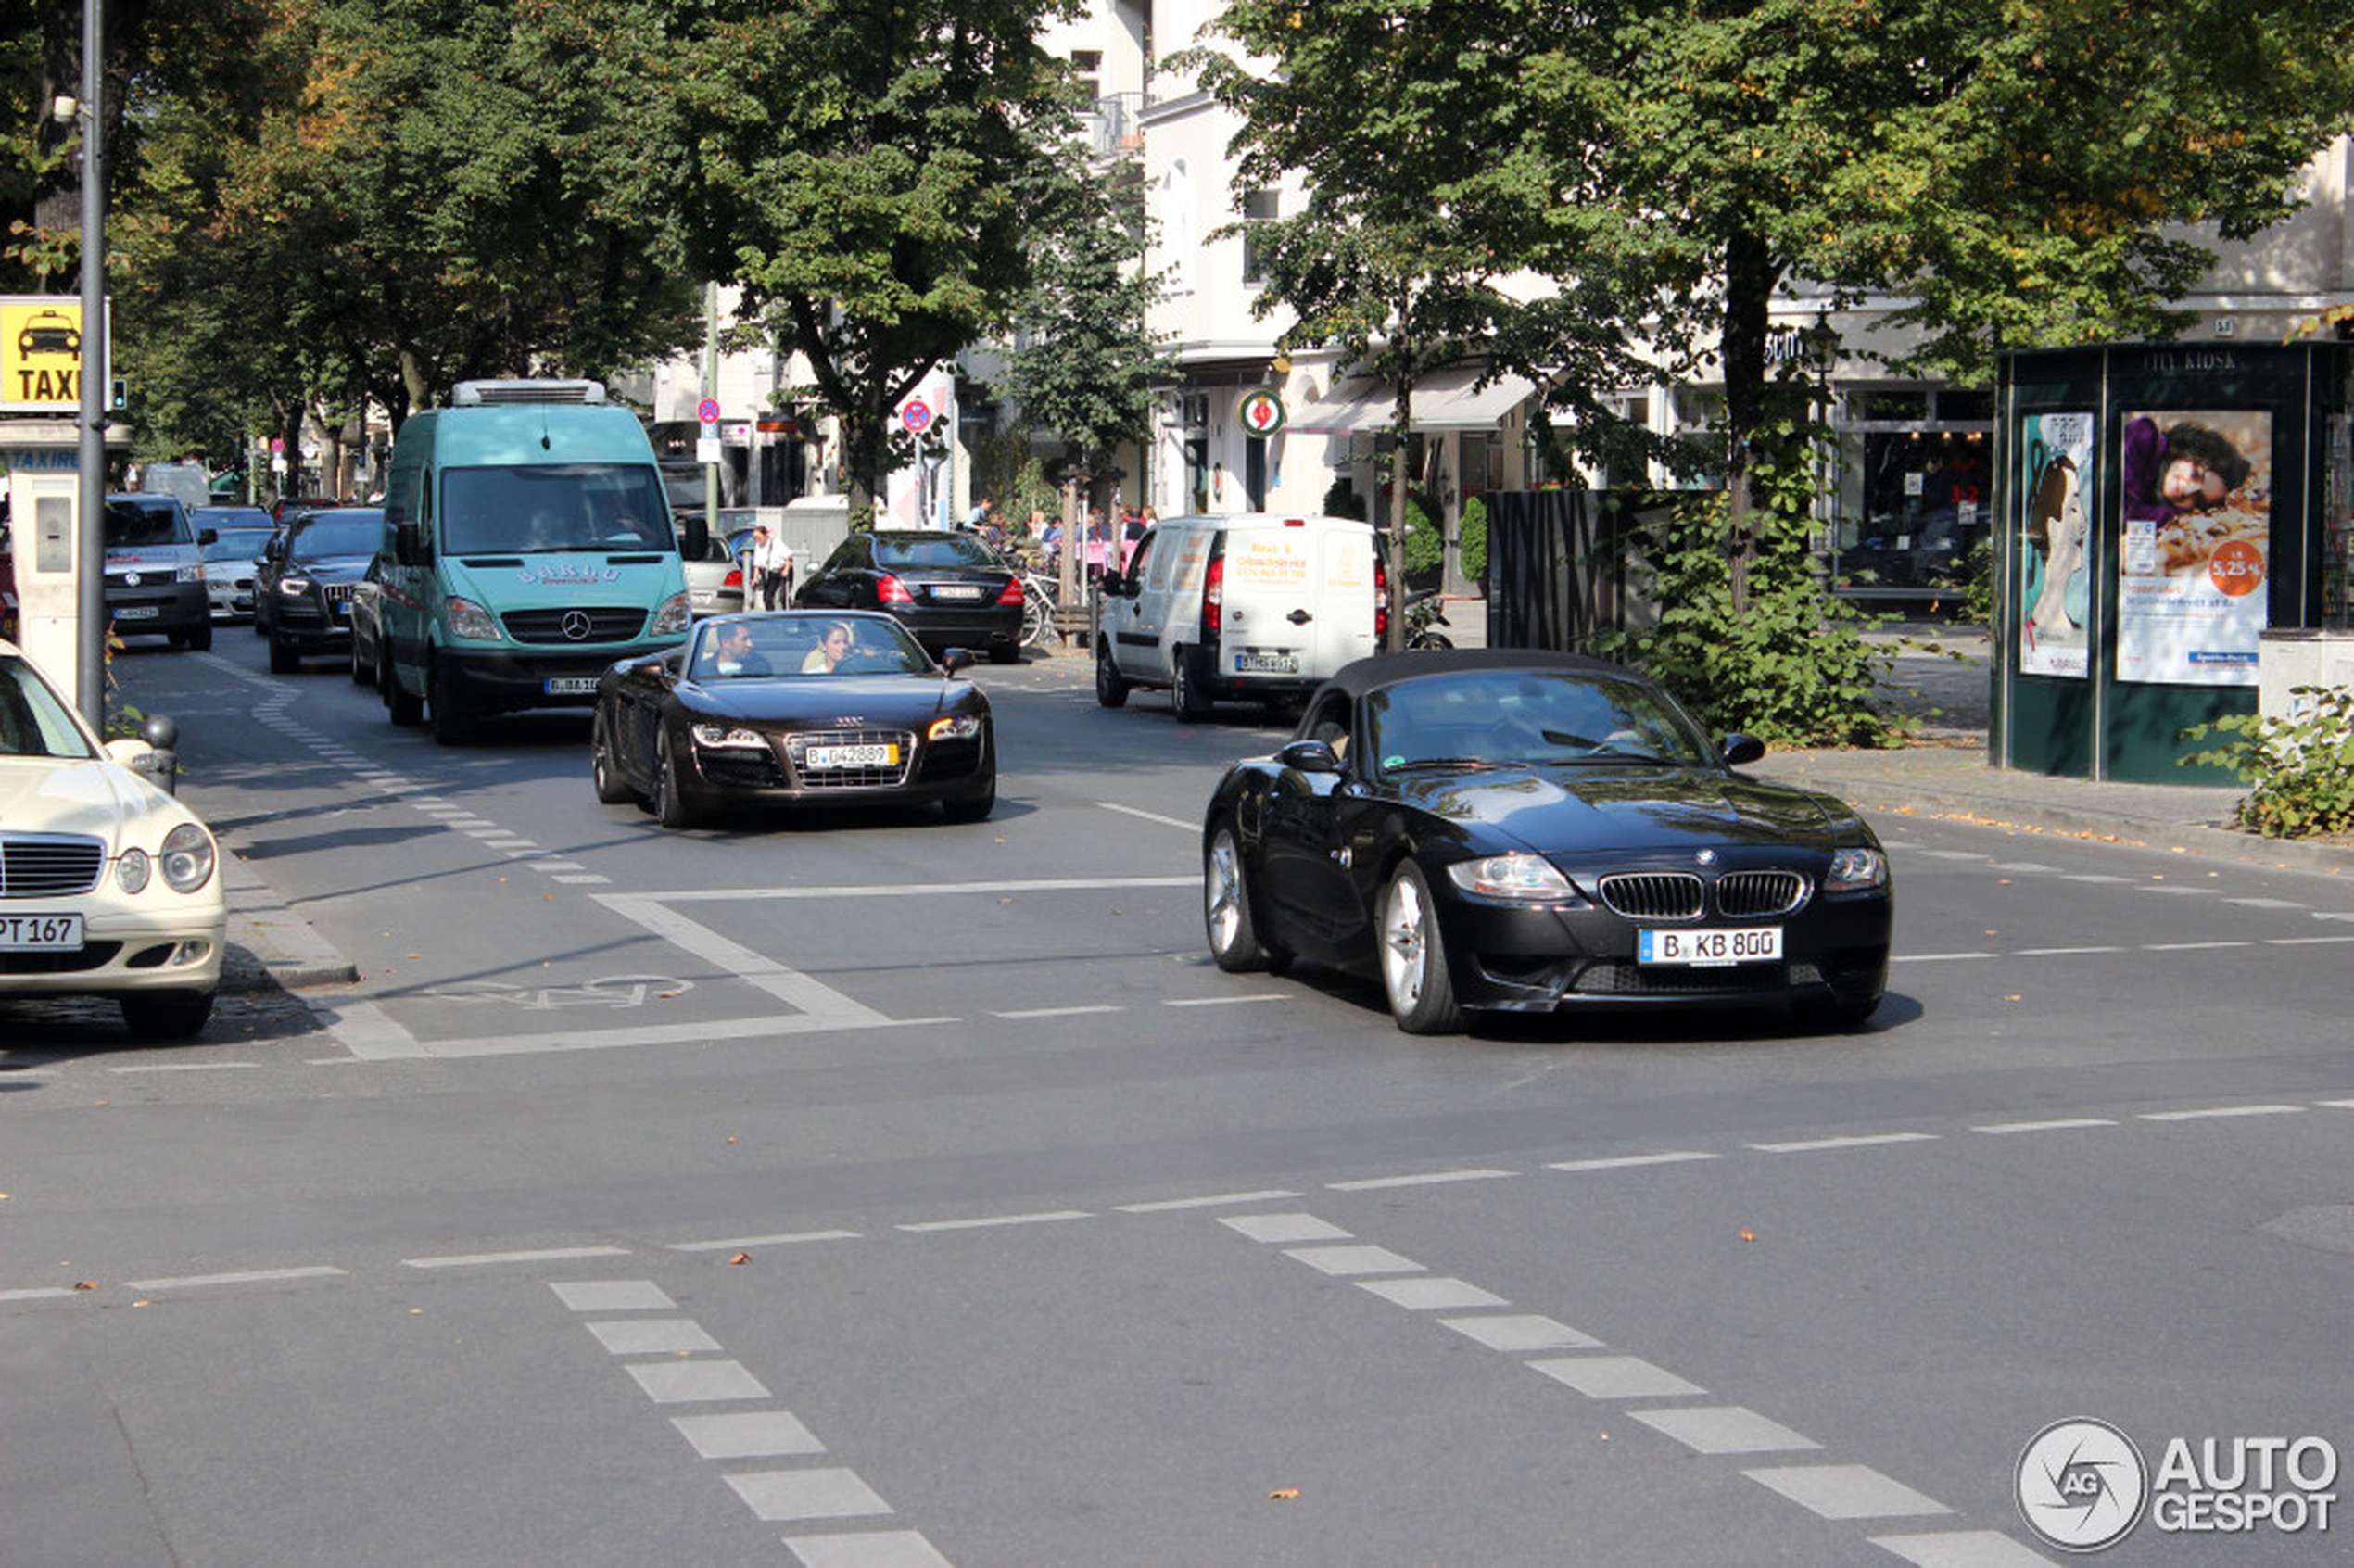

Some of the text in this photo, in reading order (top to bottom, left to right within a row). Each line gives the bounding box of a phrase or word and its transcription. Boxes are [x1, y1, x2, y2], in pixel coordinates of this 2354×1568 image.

[2213, 561, 2246, 578] 5,25
[809, 749, 819, 764] B
[28, 919, 72, 942] 167
[1664, 931, 1774, 957] B KB 800
